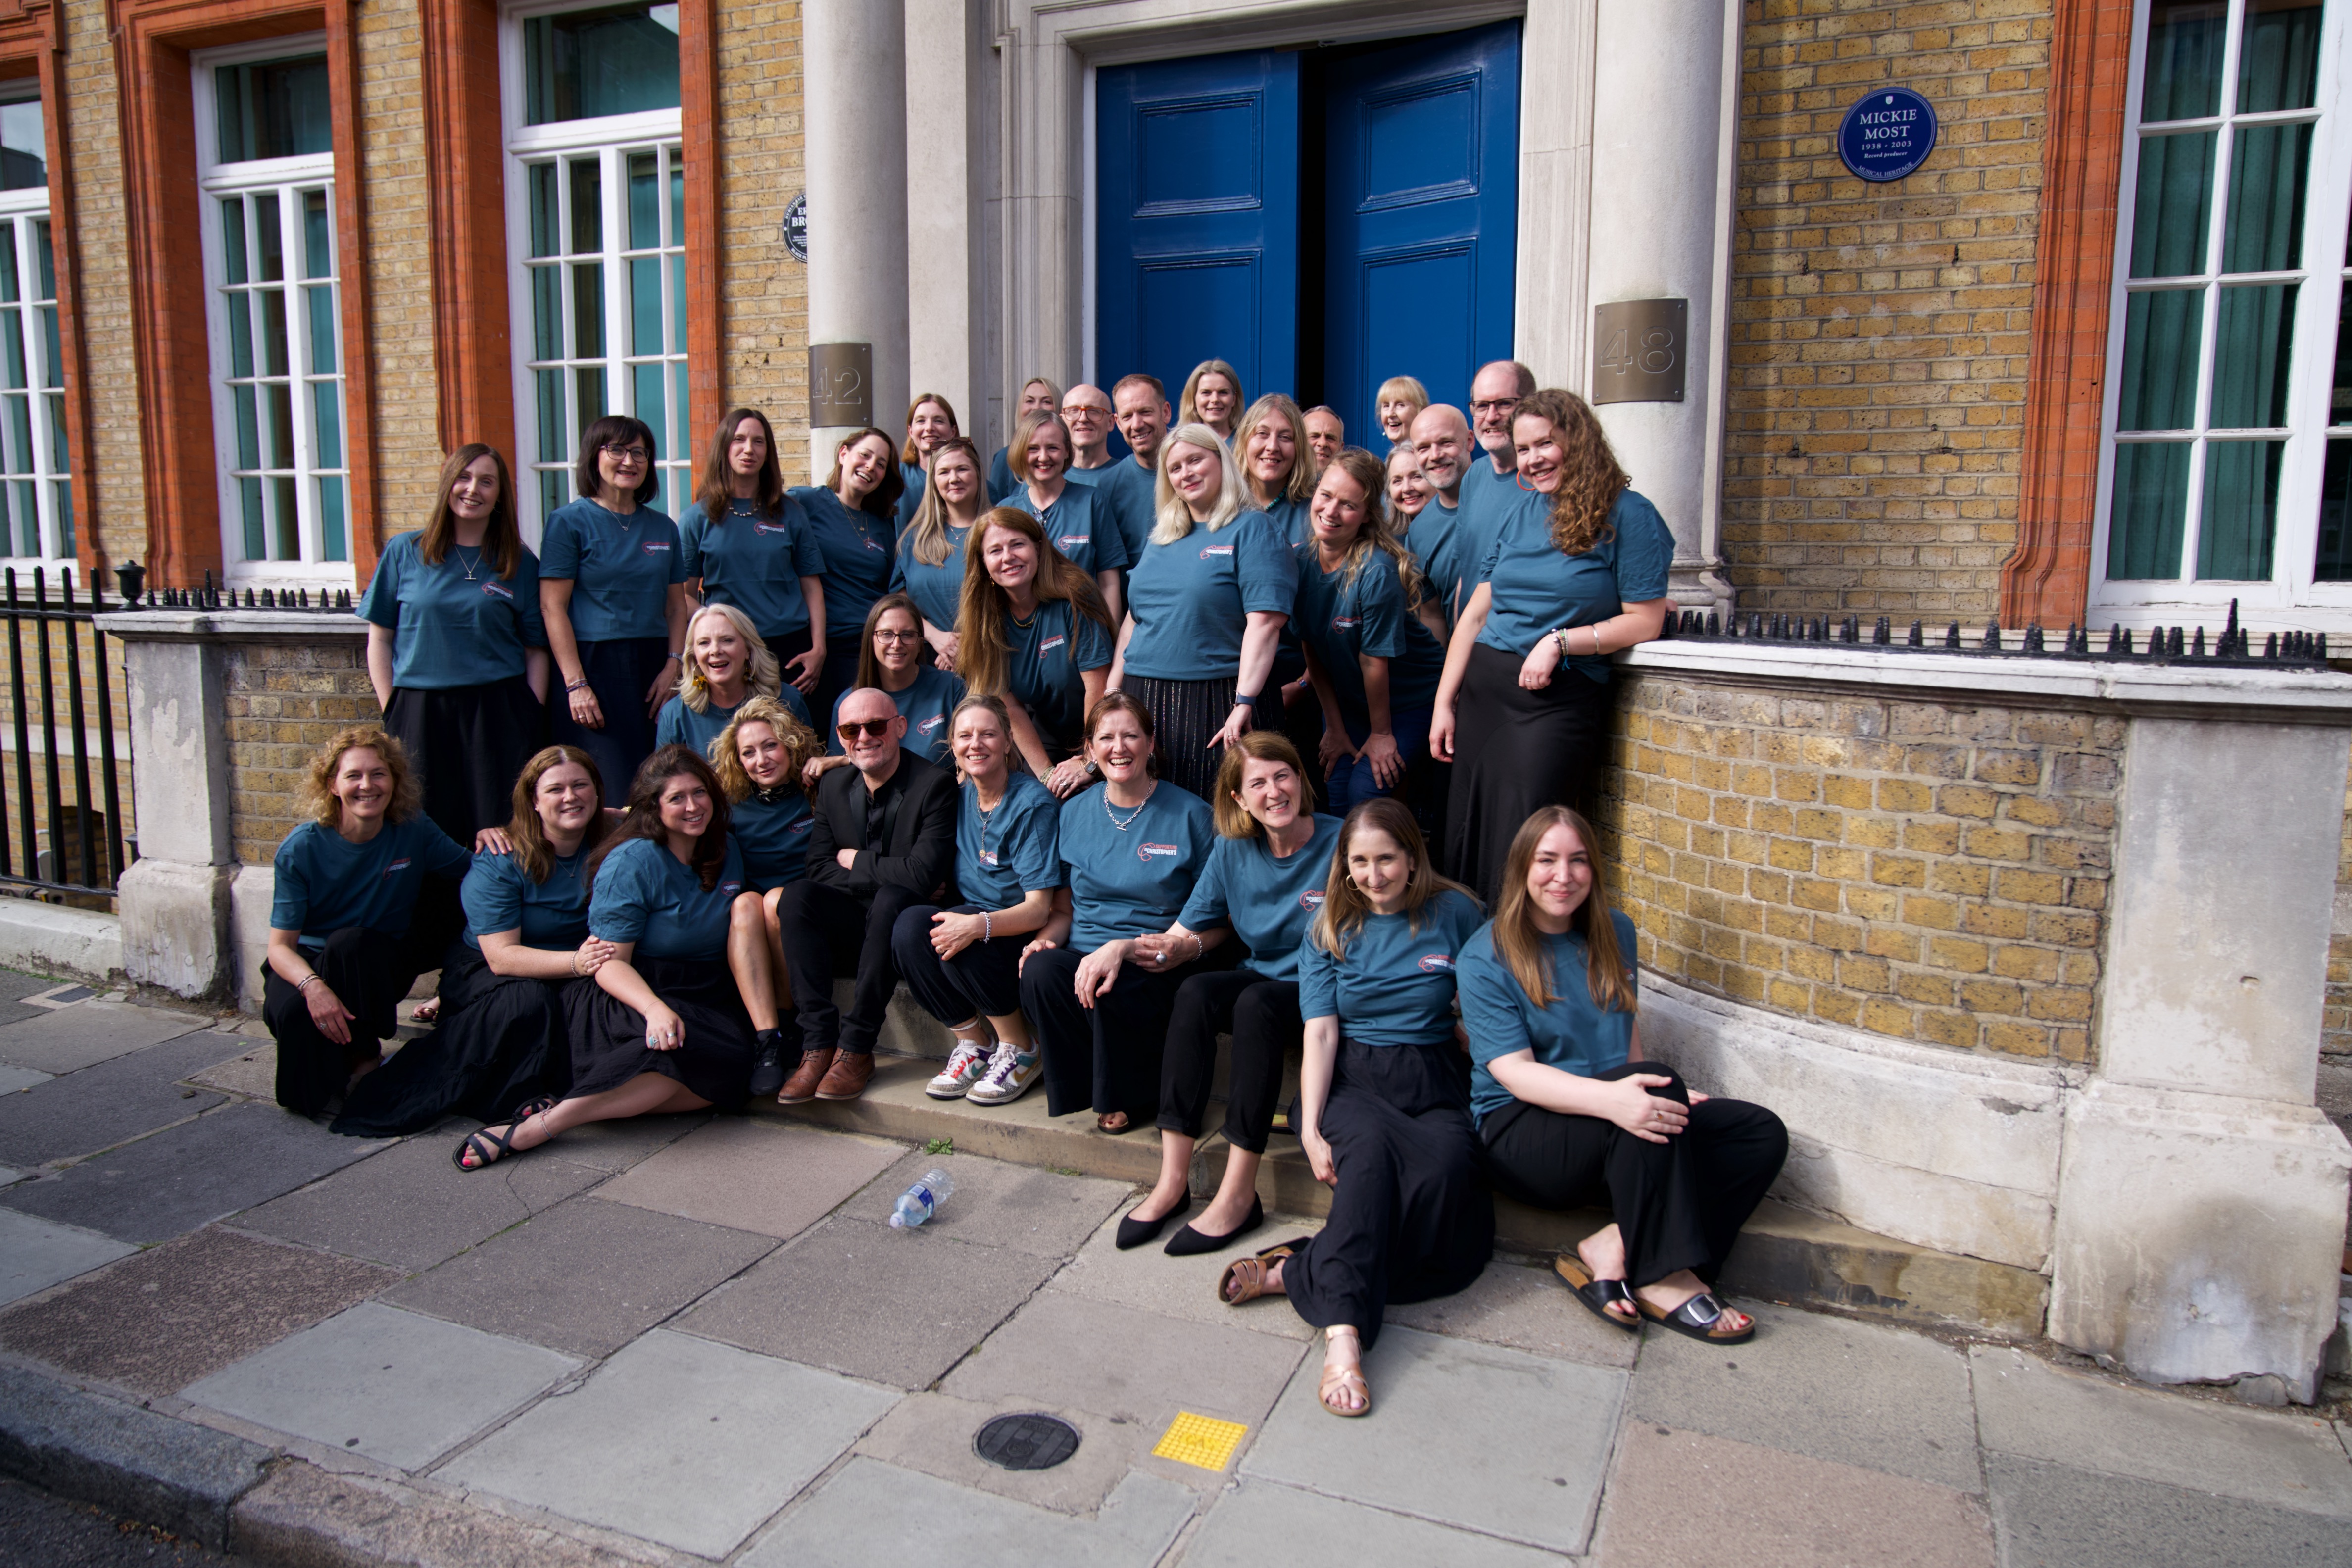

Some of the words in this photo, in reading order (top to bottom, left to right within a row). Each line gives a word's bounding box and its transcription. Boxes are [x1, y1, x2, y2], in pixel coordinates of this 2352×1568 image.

[1860, 109, 1917, 124] MICKIE
[1865, 126, 1910, 140] MOST
[1858, 165, 1883, 177] MUSICAL
[1884, 162, 1913, 177] HERITAGE
[1601, 326, 1674, 375] 48
[812, 366, 861, 404] 42
[1041, 638, 1065, 651] CHRISTOPHER'S
